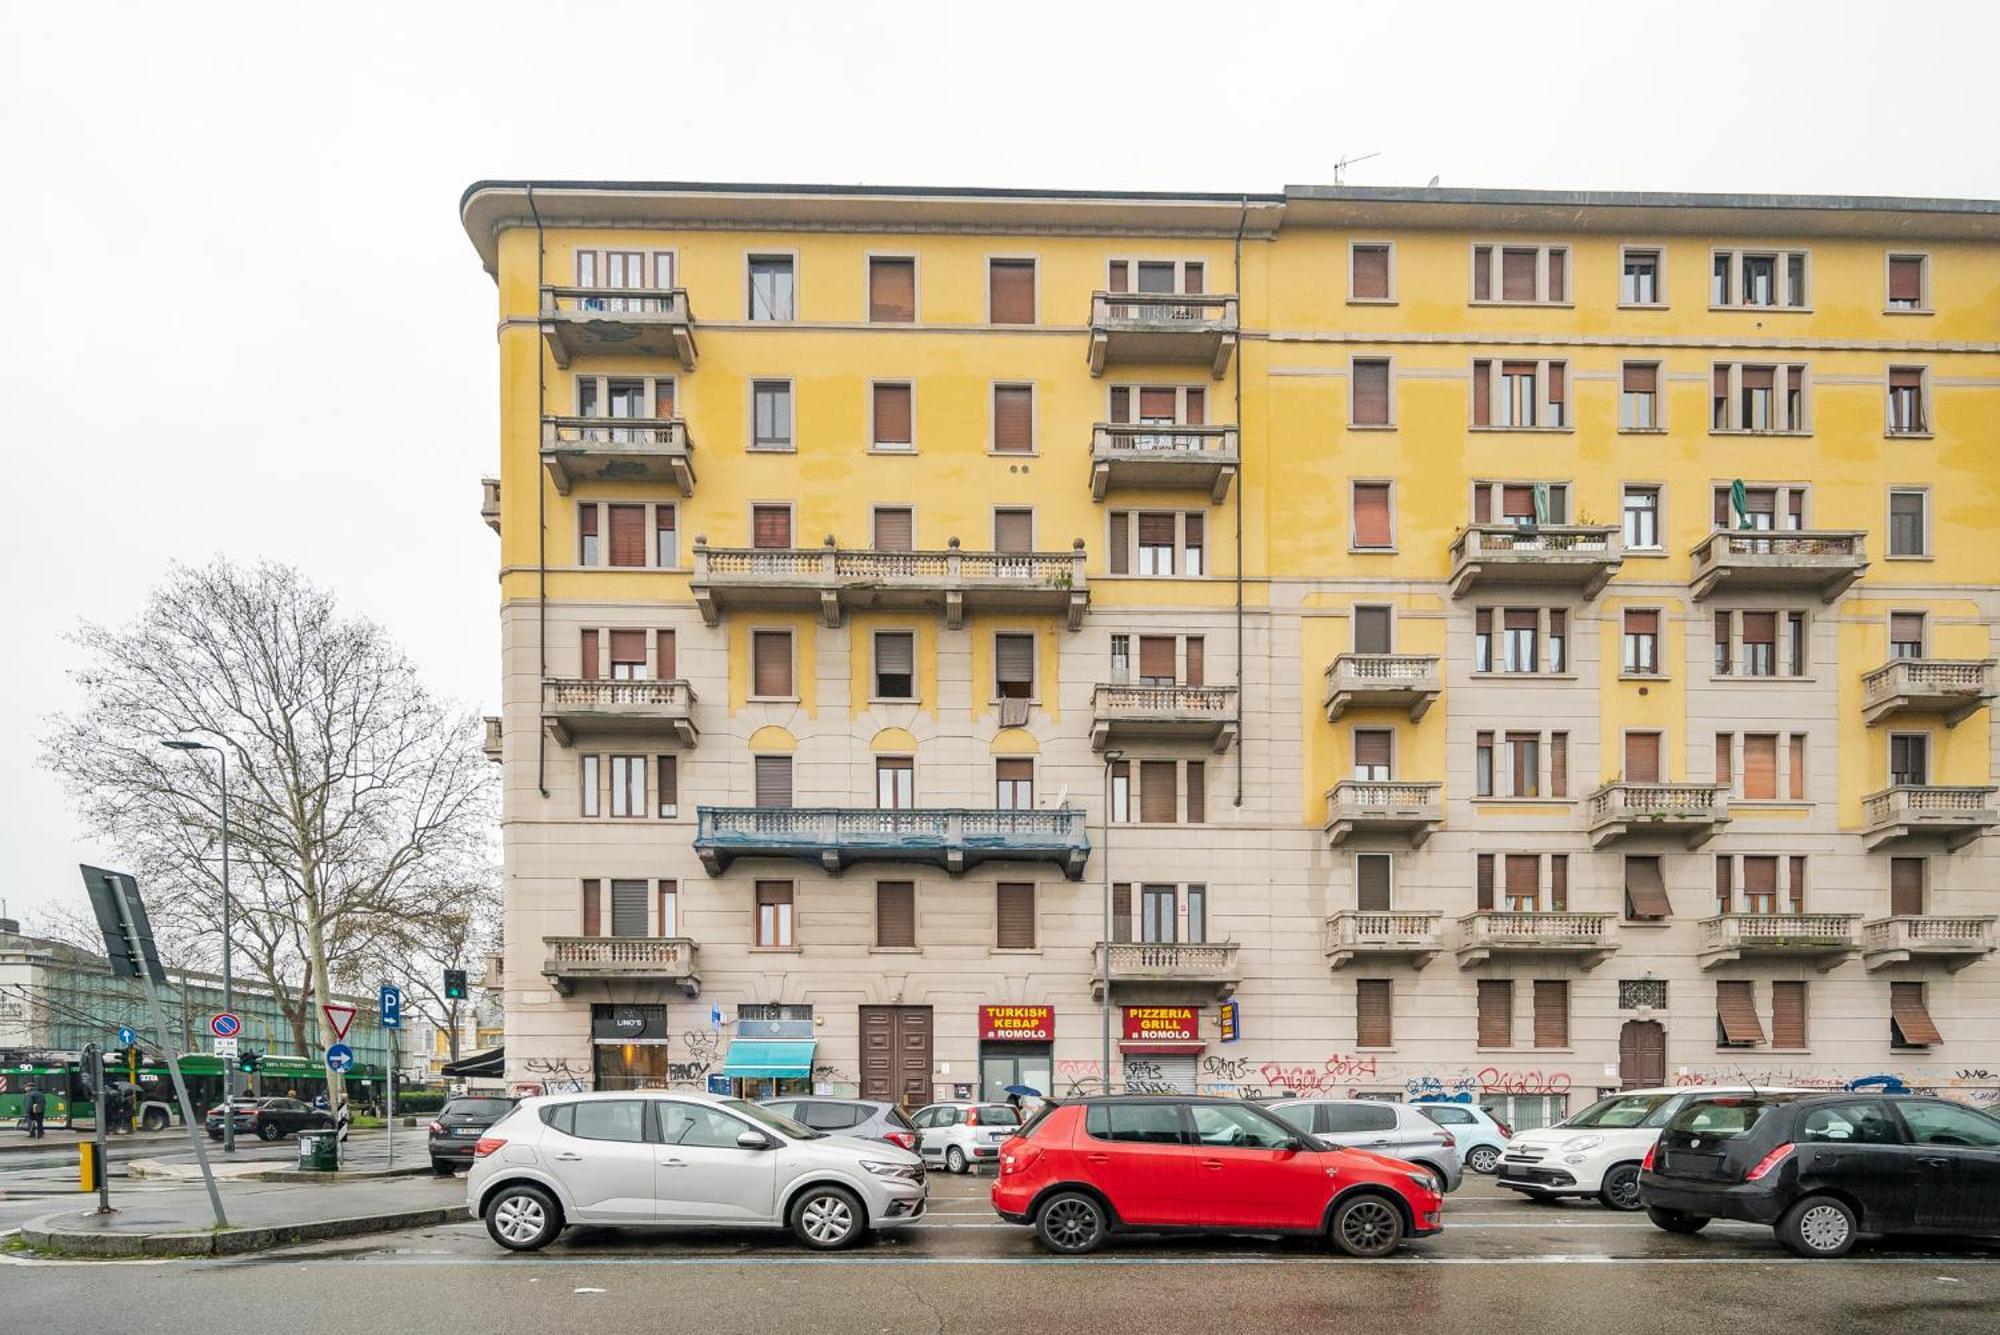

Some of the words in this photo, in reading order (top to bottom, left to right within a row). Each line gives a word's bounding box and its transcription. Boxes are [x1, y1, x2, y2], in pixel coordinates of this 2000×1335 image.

[385, 994, 396, 1014] P
[987, 1007, 1047, 1018] TURKISH
[1130, 1009, 1191, 1019] PIZZERIA
[994, 1019, 1039, 1028] KEBAP
[1141, 1020, 1180, 1029] GRILL
[998, 1030, 1046, 1038] ROMOLO
[1142, 1031, 1190, 1039] ROMOLO
[19, 1064, 33, 1072] 90
